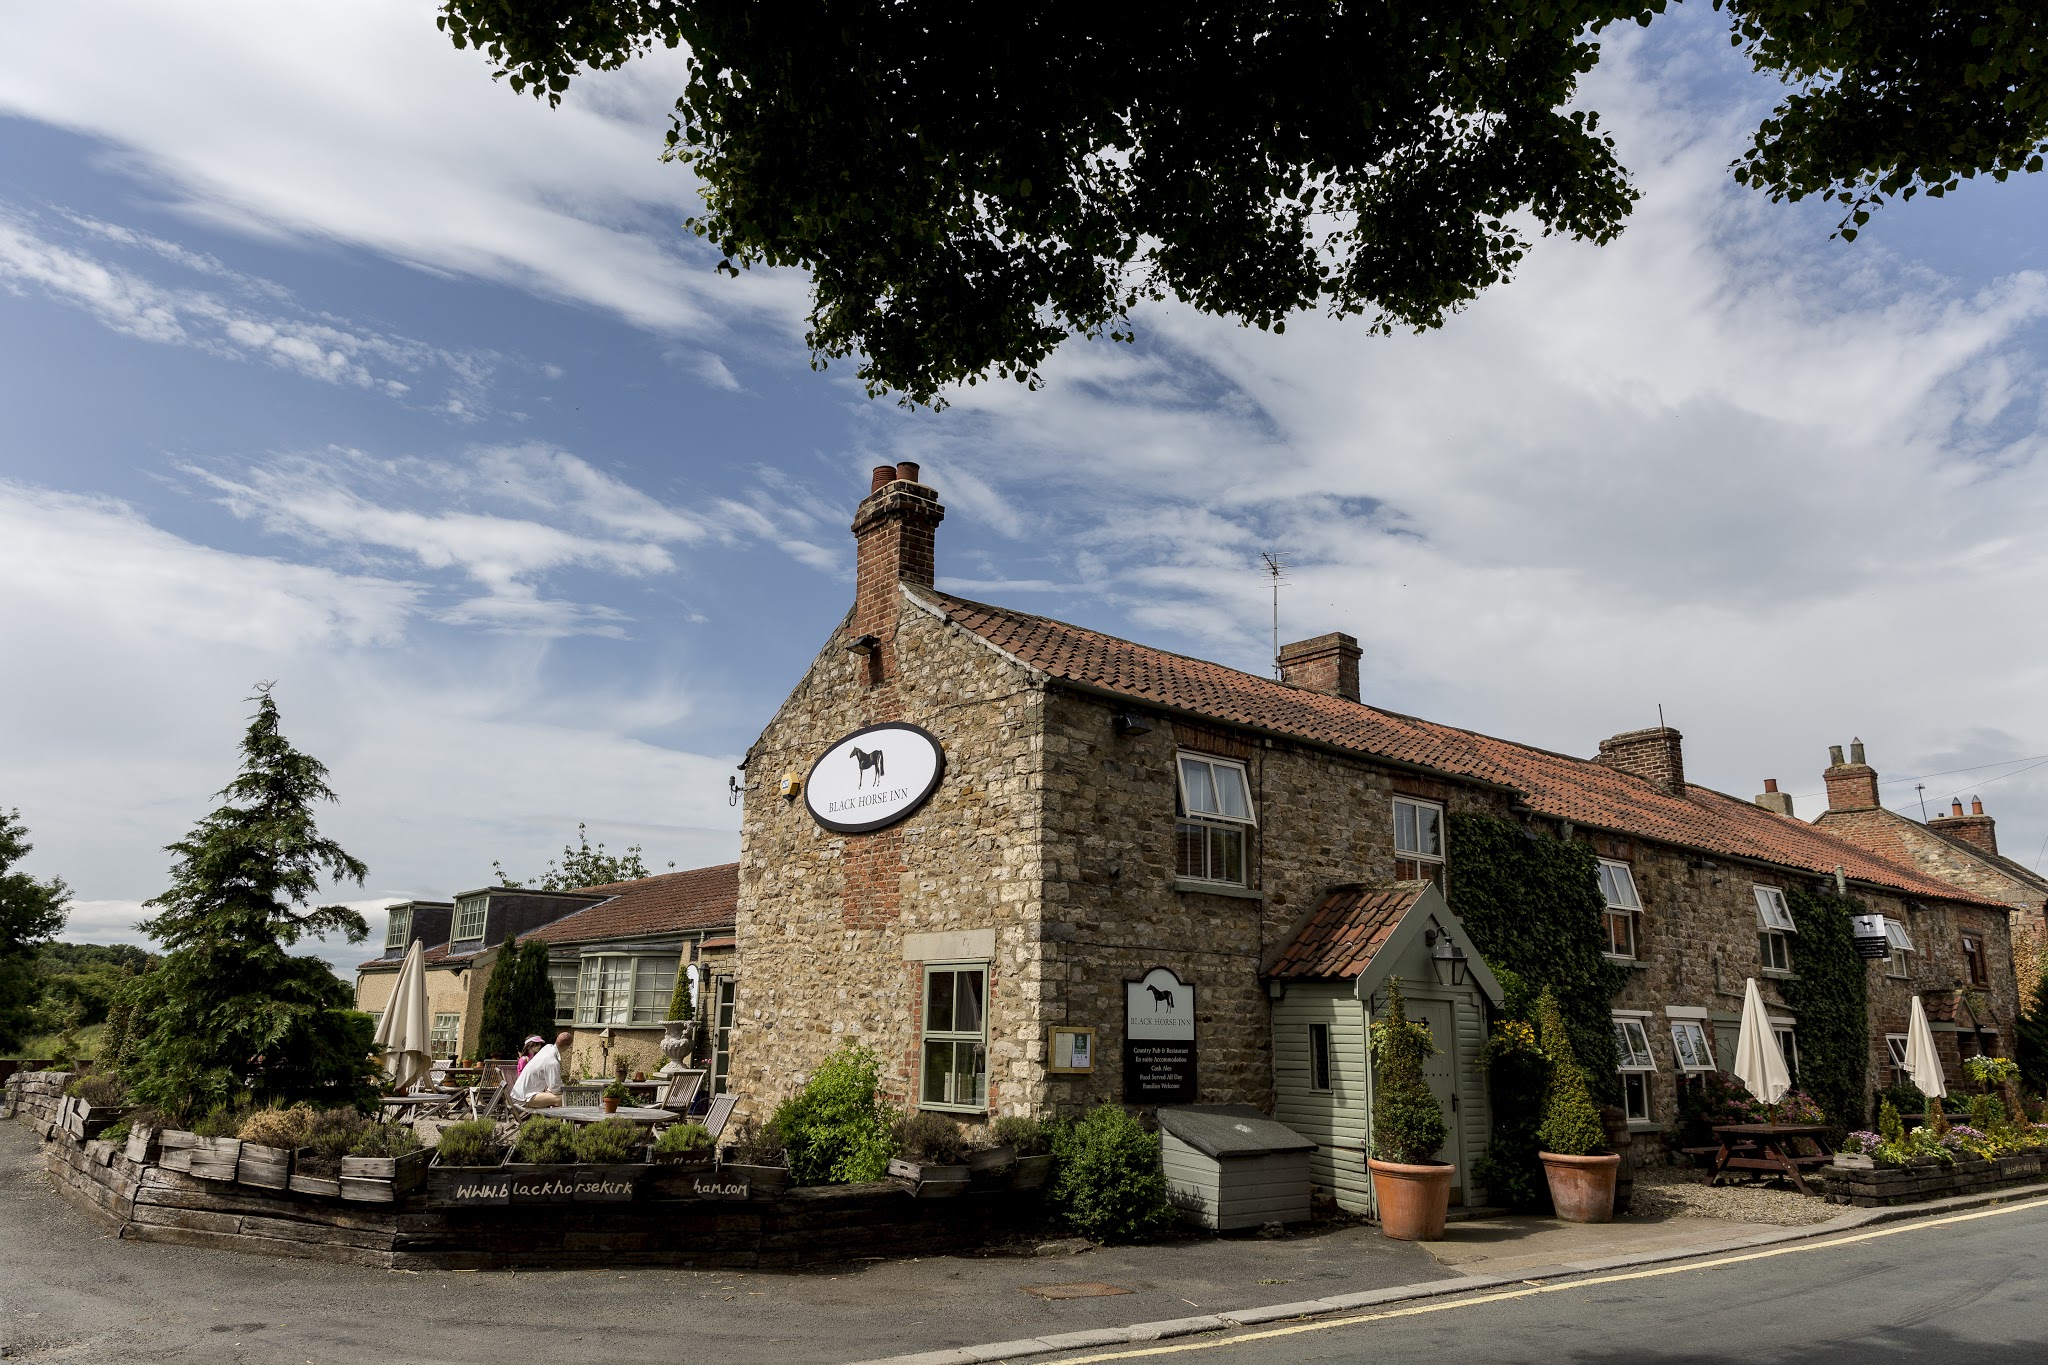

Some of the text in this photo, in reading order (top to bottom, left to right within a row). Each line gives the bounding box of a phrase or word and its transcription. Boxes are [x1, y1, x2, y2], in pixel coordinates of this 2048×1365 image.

[829, 788, 908, 813] BLACK HORSE INN
[1130, 1017, 1191, 1026] BLACK HORSE INN
[1133, 1047, 1152, 1055] Country
[1174, 1074, 1183, 1082] Day
